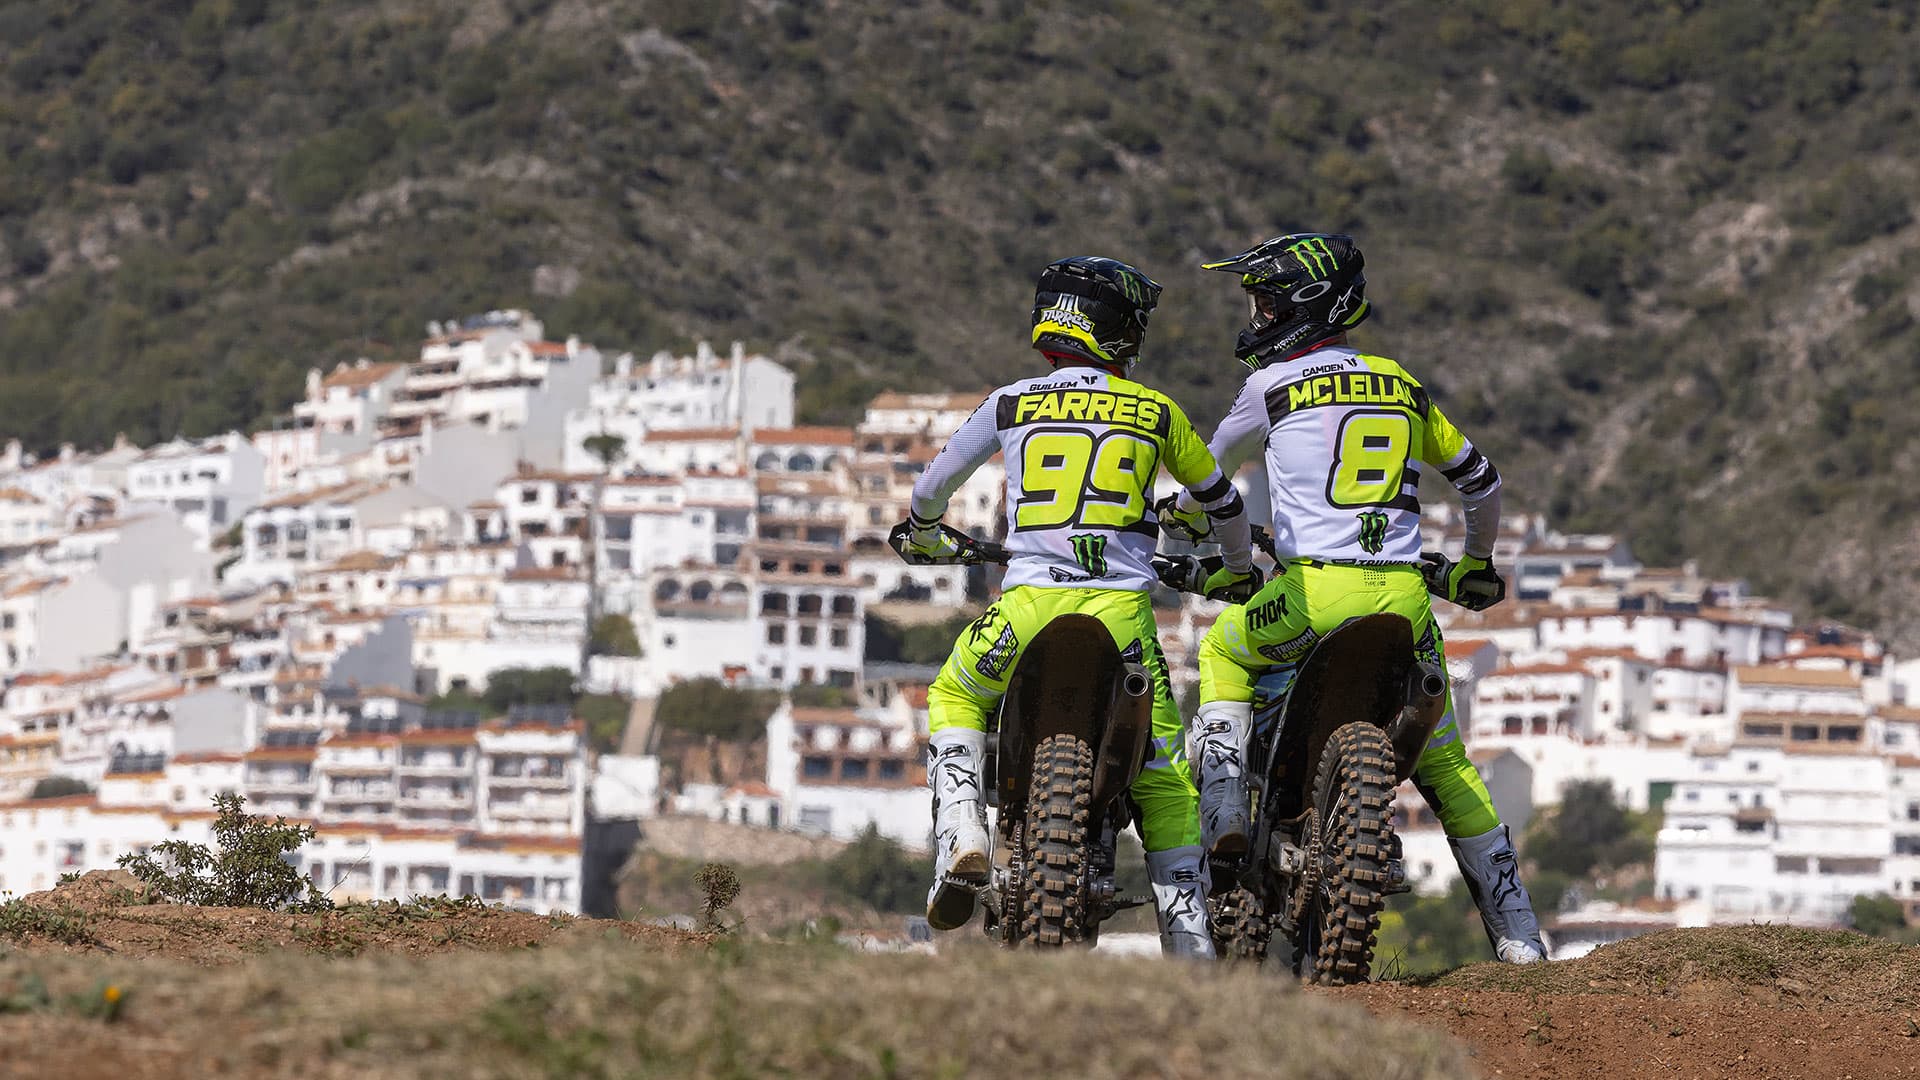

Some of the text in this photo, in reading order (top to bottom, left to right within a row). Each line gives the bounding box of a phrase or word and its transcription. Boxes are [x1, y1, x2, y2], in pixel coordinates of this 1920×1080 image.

[1029, 381, 1078, 391] GUILLEM
[1302, 363, 1344, 377] CAMDEN
[1015, 391, 1161, 431] FARRES
[1325, 409, 1411, 509] 8
[1015, 427, 1160, 533] 99
[1246, 593, 1290, 632] THOR
[1276, 628, 1316, 655] TRIUMPH
